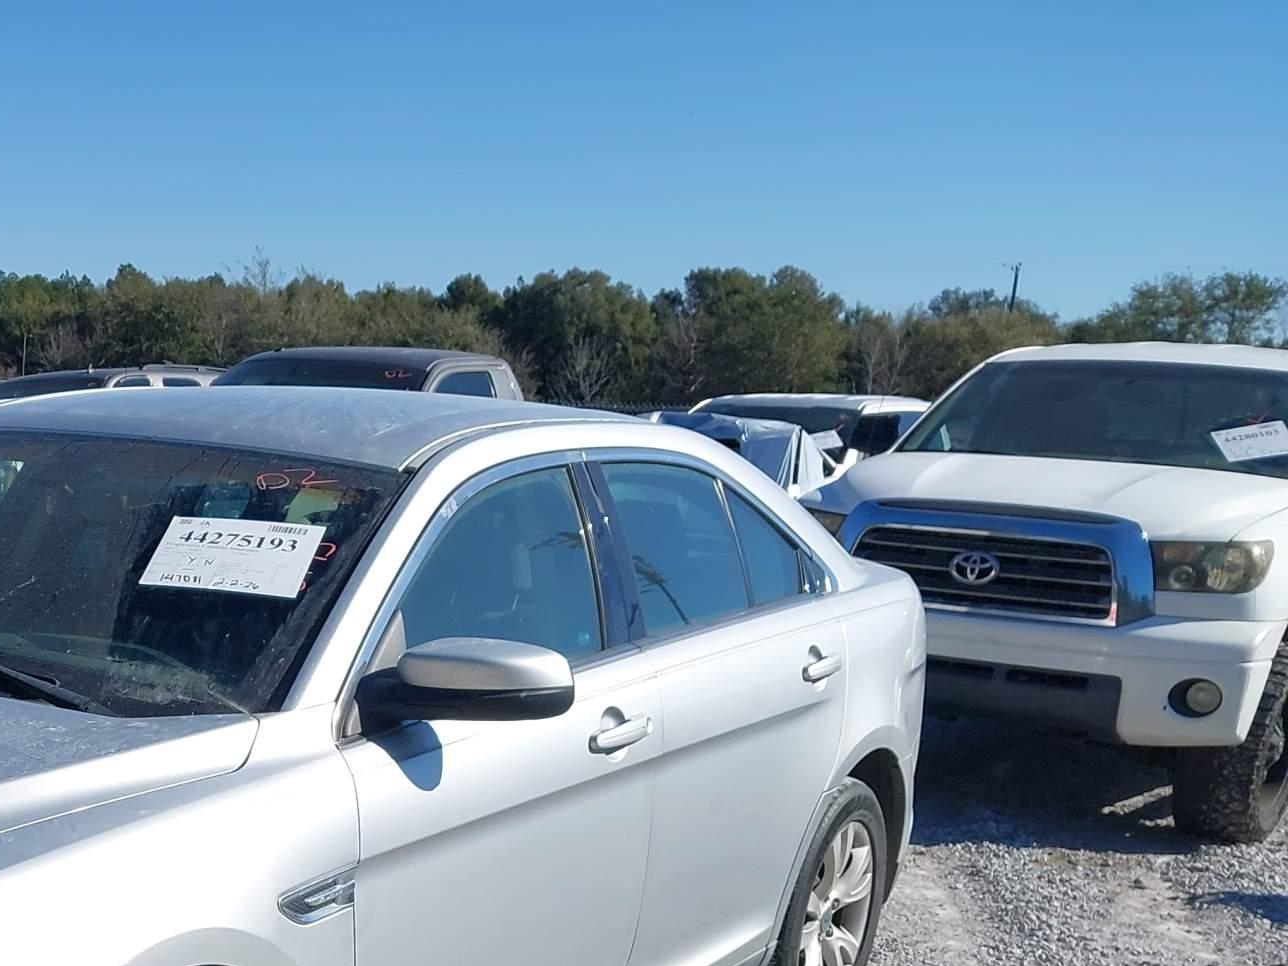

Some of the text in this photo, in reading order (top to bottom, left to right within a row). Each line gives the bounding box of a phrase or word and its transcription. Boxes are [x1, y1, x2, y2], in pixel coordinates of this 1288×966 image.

[178, 529, 299, 553] 44275193
[187, 555, 198, 565] Y
[204, 559, 215, 567] N
